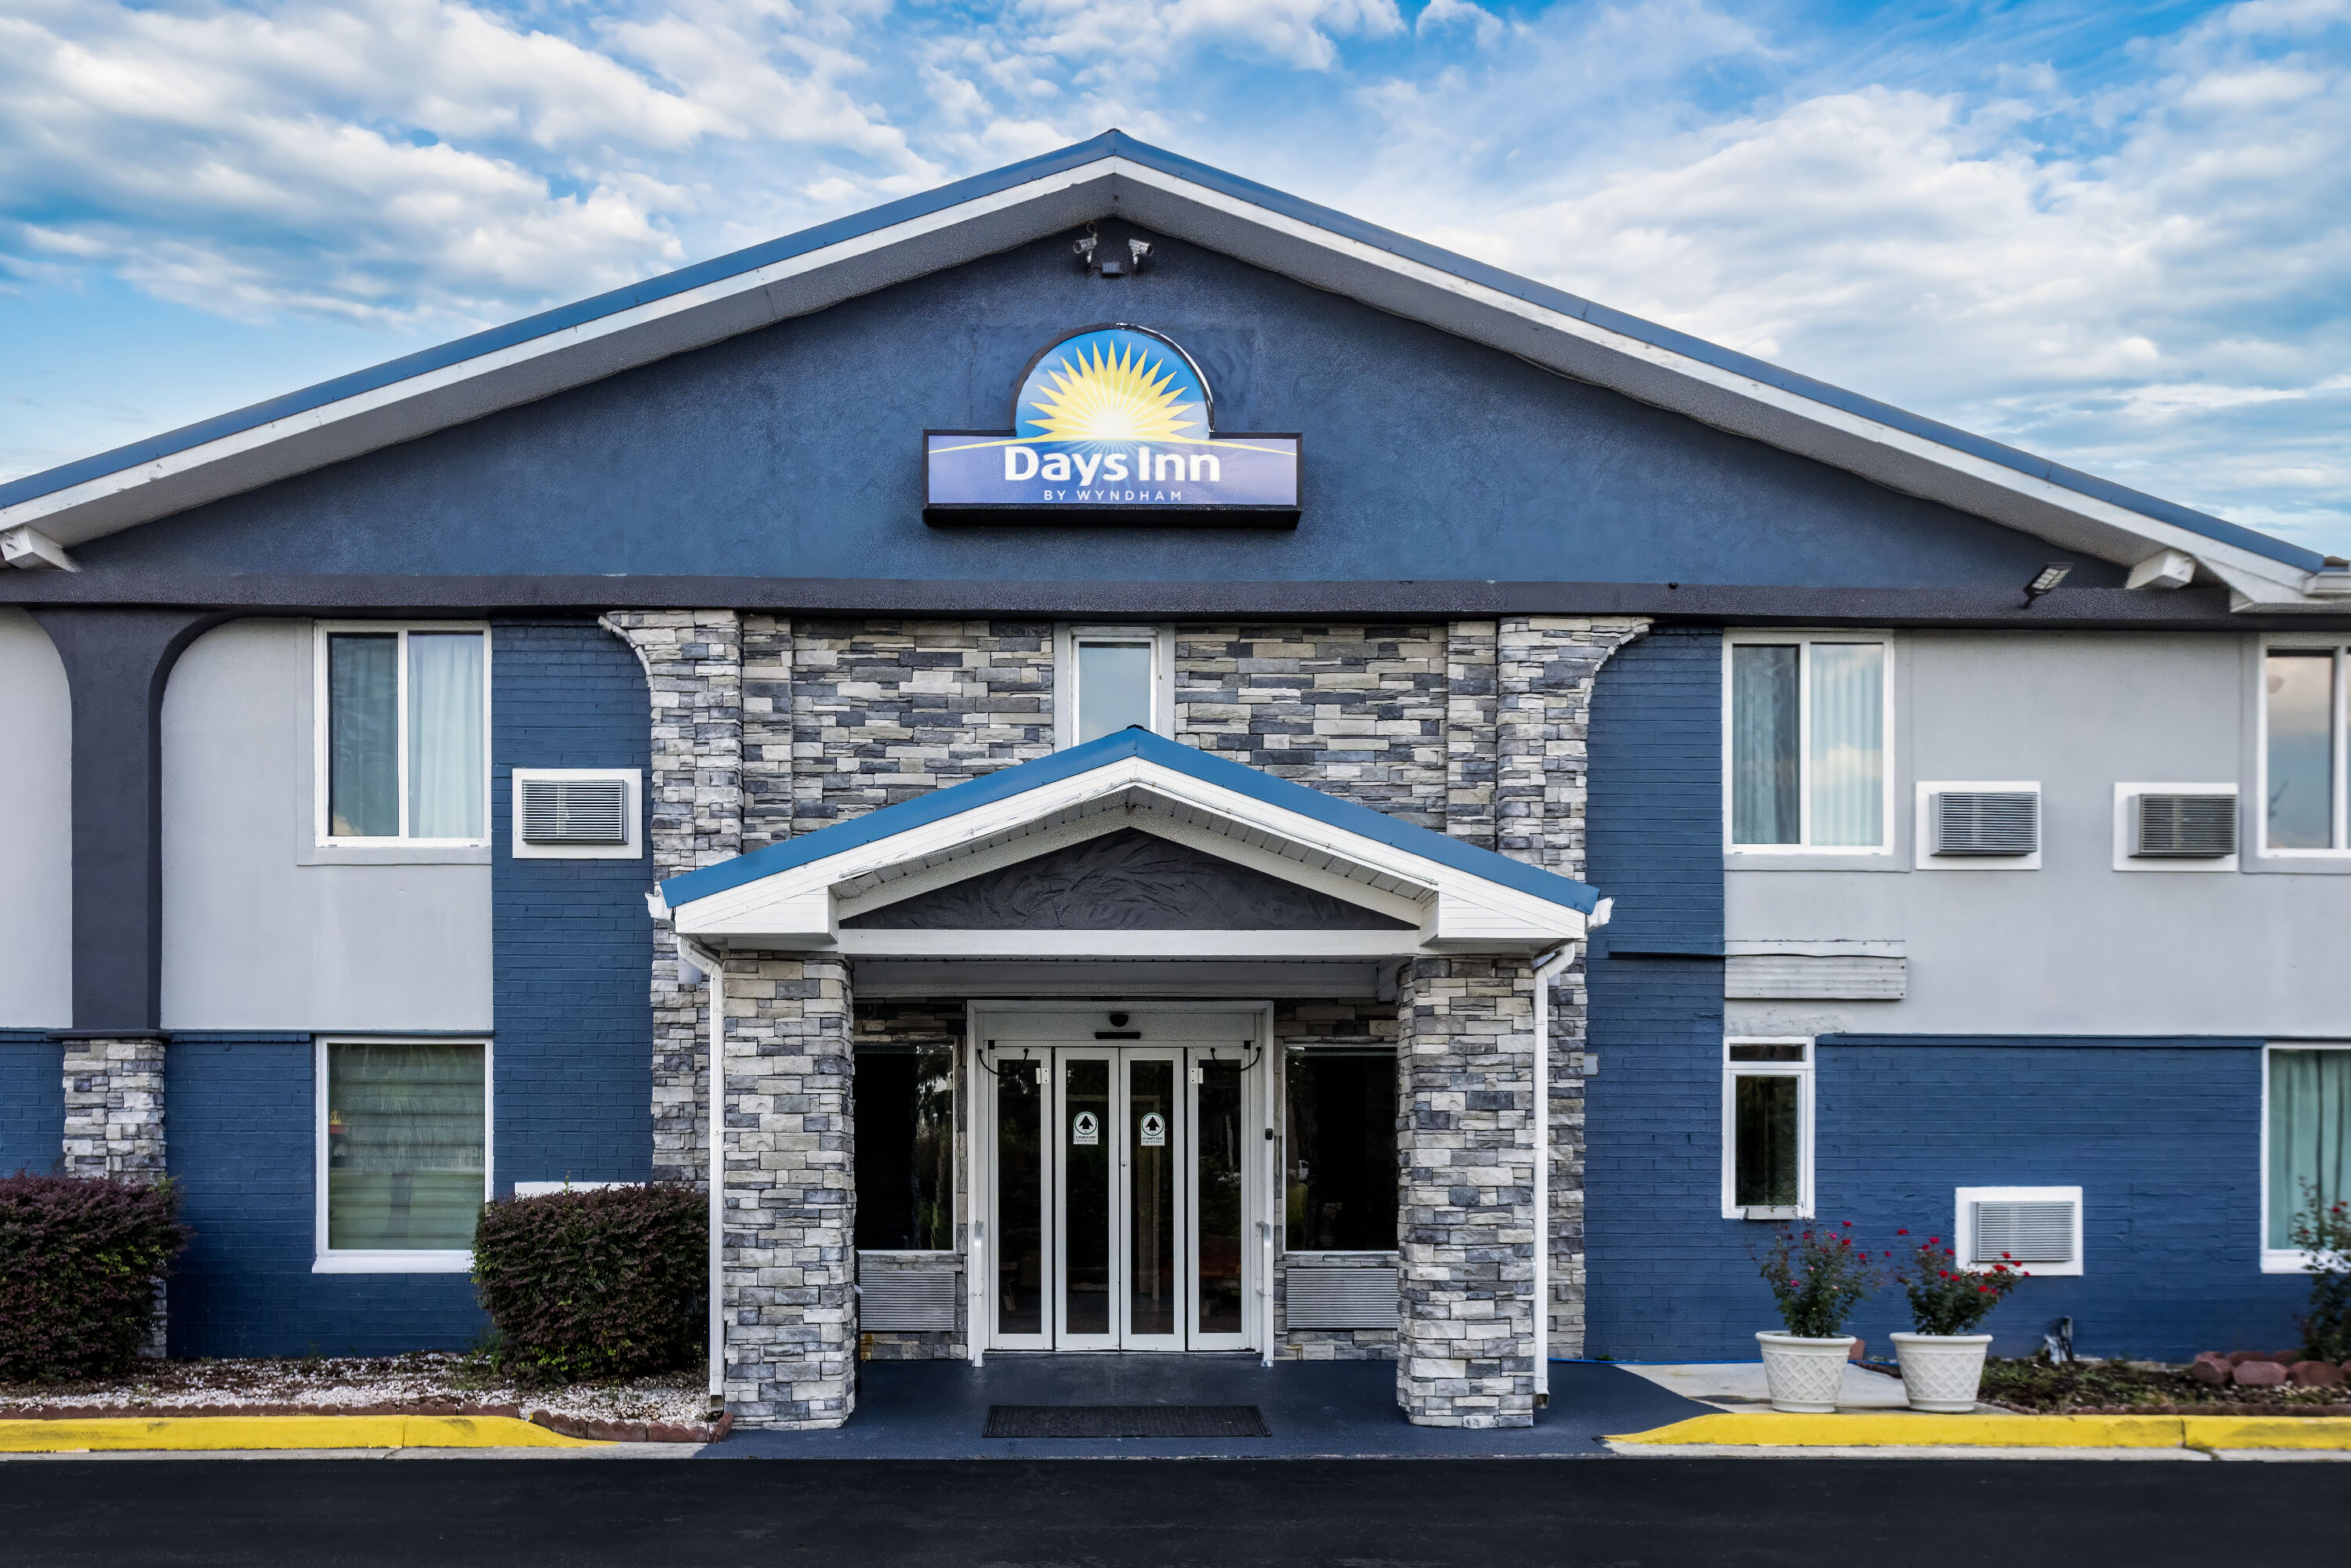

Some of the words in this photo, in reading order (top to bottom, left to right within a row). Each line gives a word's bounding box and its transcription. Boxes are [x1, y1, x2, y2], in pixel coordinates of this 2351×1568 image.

[1004, 446, 1129, 487] Days
[1138, 446, 1220, 482] Inn
[1044, 490, 1066, 501] BY
[1076, 490, 1183, 502] WYNDHAM
